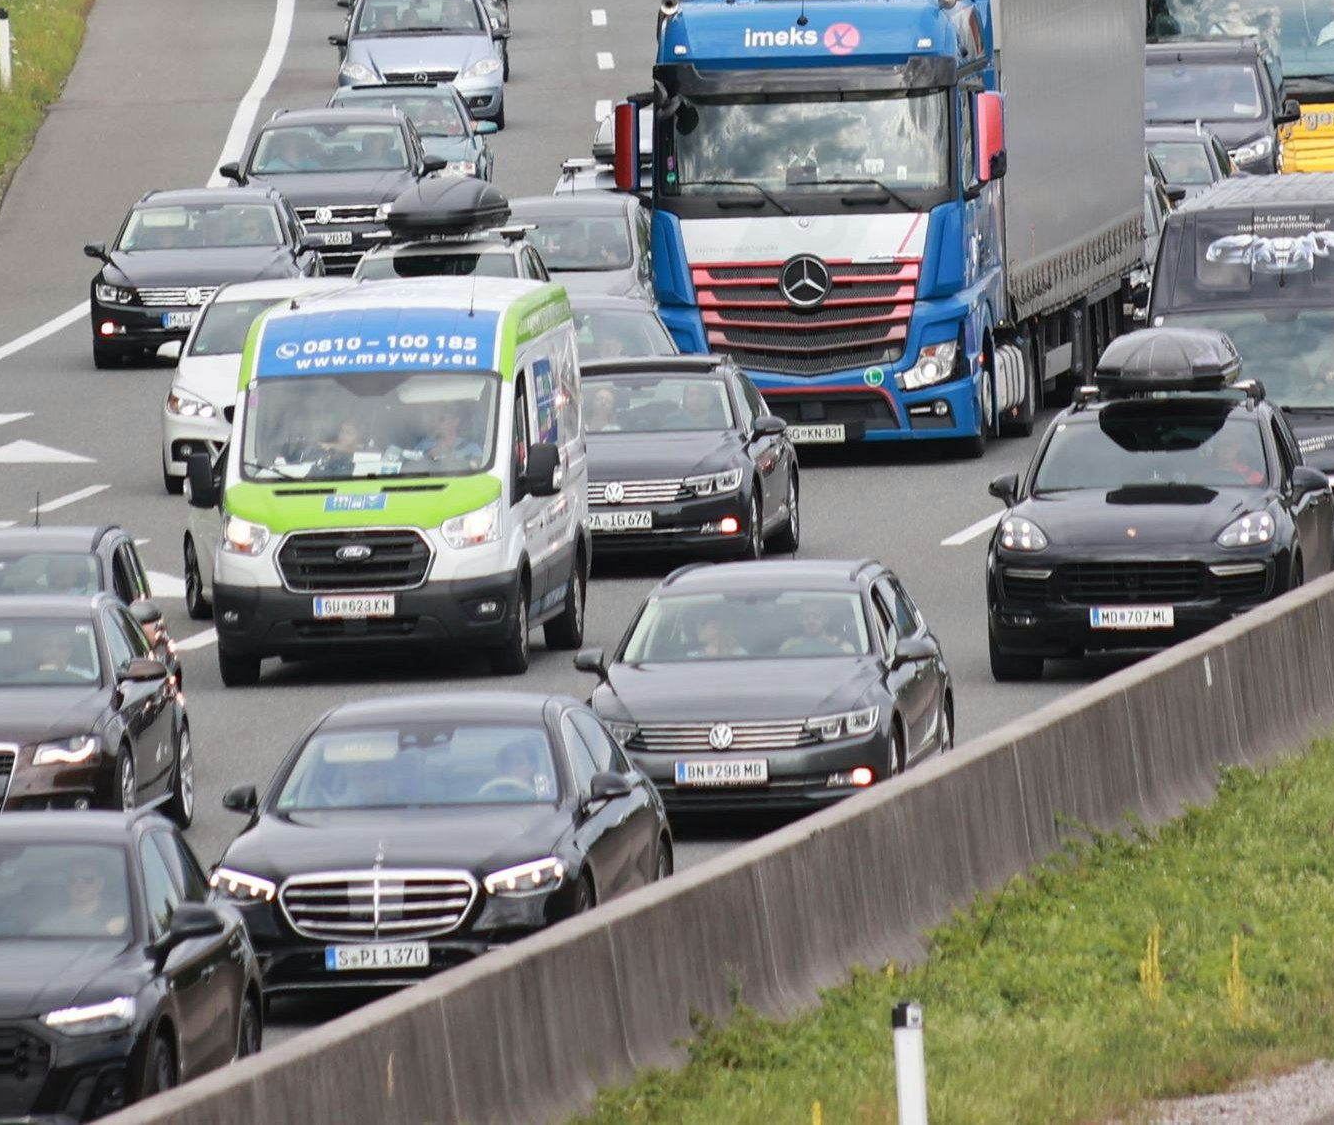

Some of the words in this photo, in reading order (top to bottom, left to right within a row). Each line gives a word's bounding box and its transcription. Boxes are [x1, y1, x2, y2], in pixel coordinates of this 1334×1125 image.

[745, 27, 818, 47] imeks
[1254, 215, 1265, 223] Ihr
[1267, 215, 1296, 223] Experte
[1299, 214, 1310, 222] für
[327, 234, 351, 244] 2016
[303, 337, 361, 354] 0810
[387, 335, 428, 349] 100
[436, 335, 477, 350] 185
[296, 352, 476, 369] www.mayway.eu
[628, 513, 650, 525] 676
[1128, 611, 1149, 623] 707
[715, 764, 740, 778] 298
[338, 950, 348, 966] S
[383, 946, 424, 965] 1370
